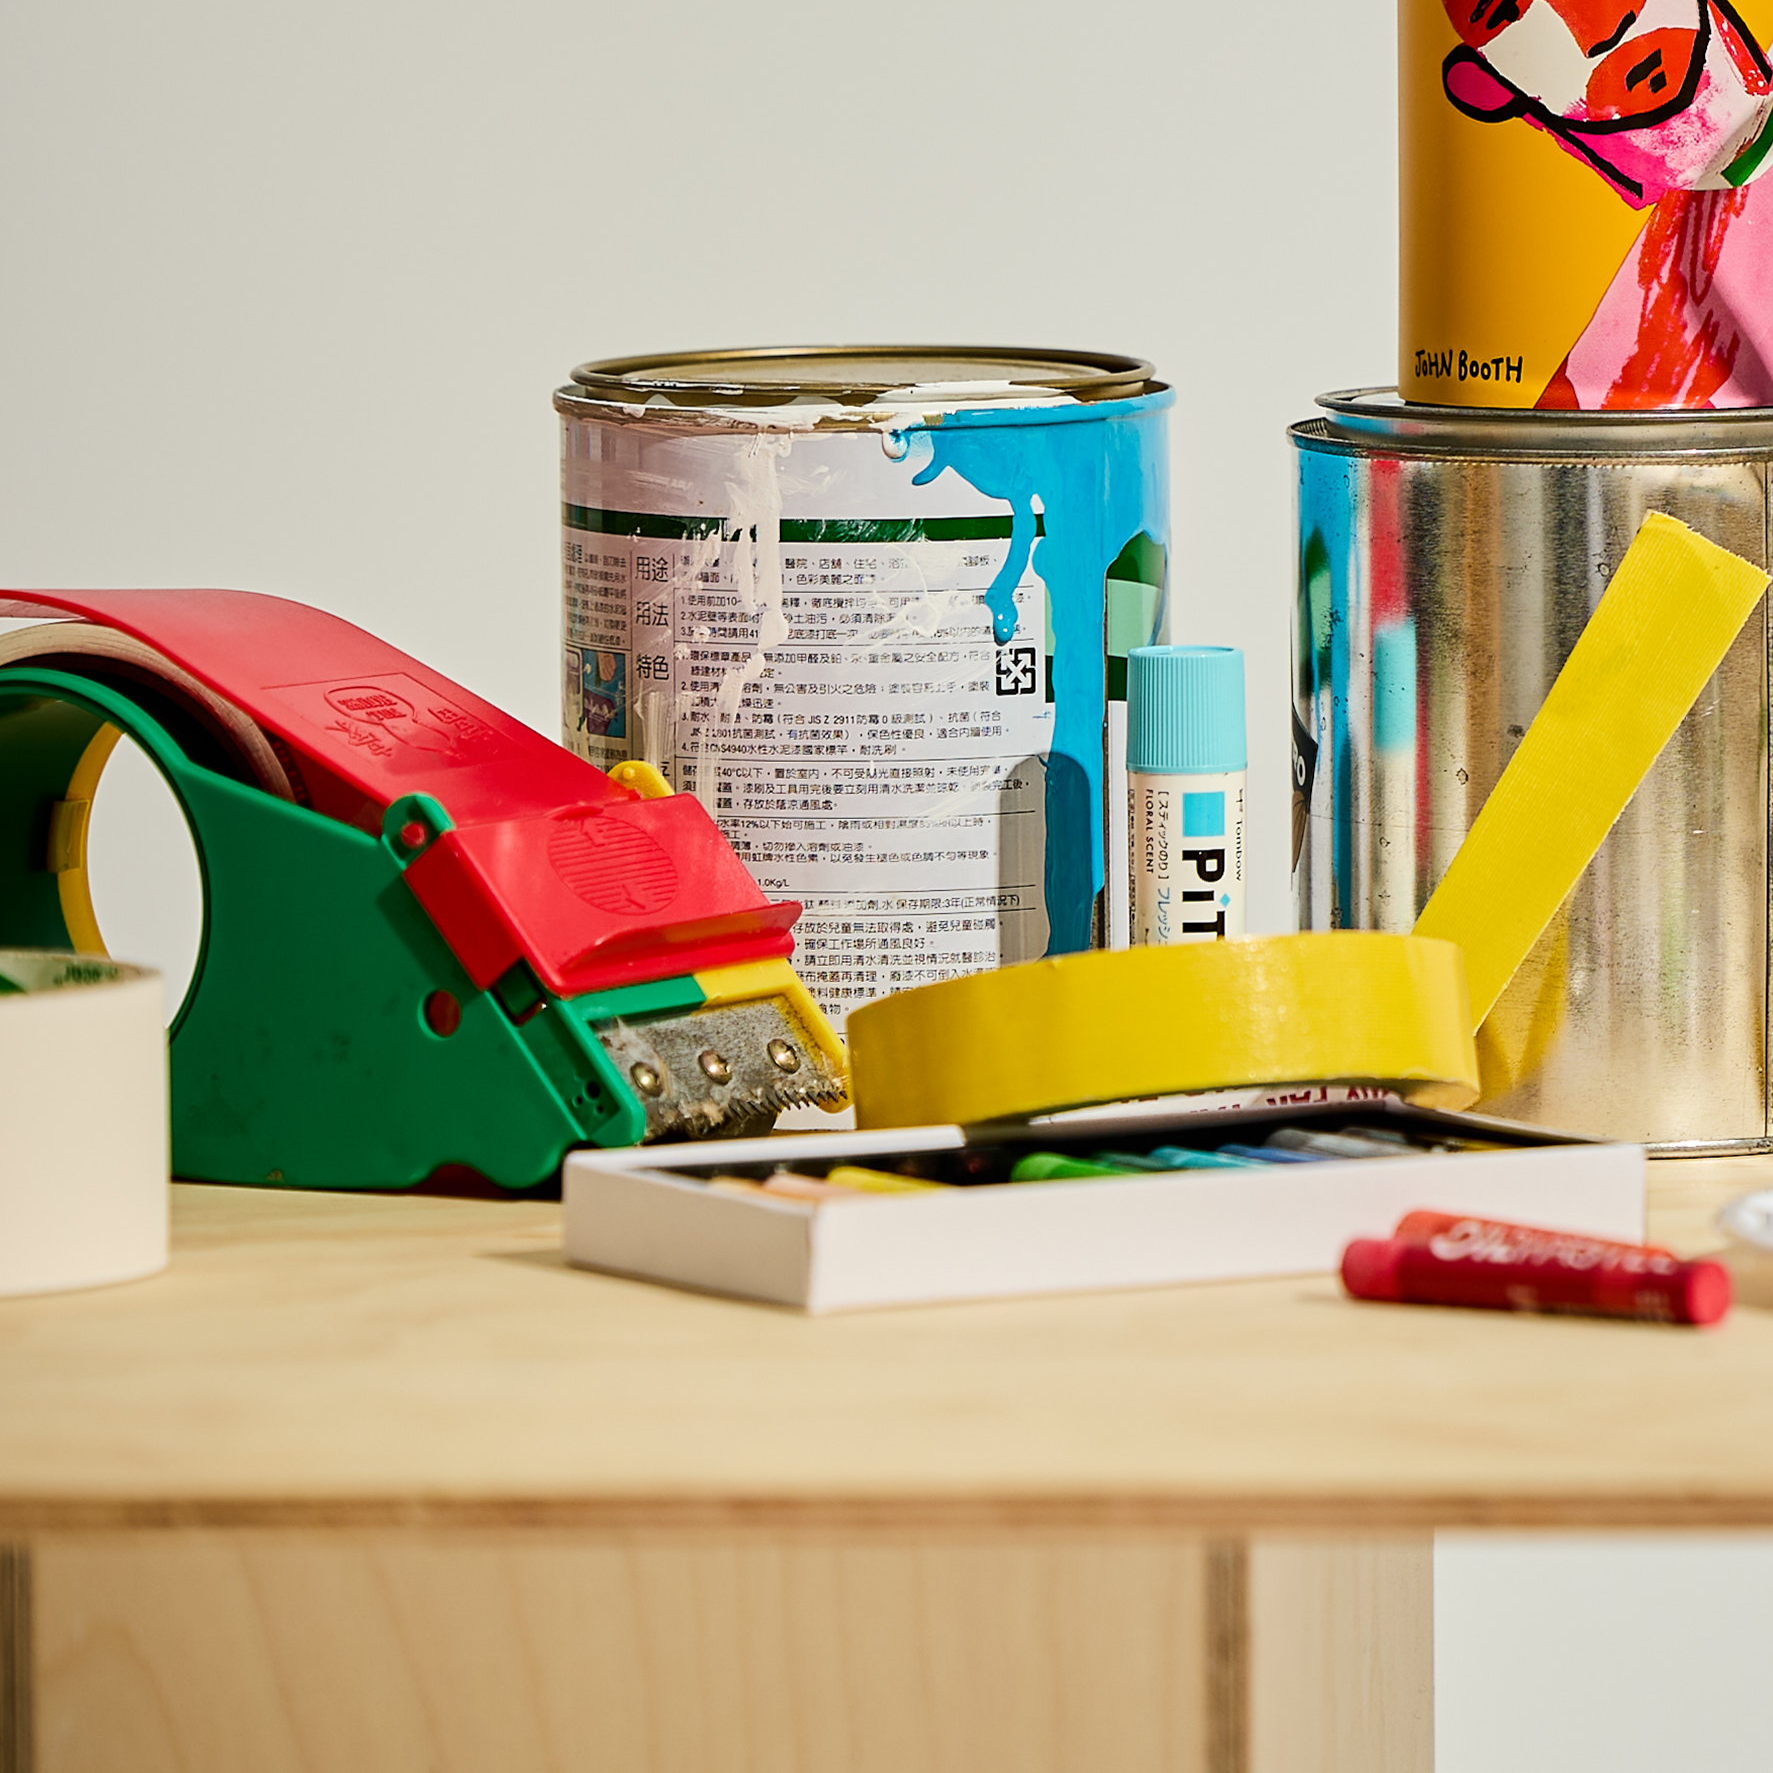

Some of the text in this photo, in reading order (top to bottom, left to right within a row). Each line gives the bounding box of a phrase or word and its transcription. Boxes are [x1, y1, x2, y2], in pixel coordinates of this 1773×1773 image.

[1458, 348, 1524, 384] BOOTH
[635, 555, 669, 583] 用途
[635, 600, 669, 627] 用法
[635, 654, 670, 681] 特色
[1145, 788, 1154, 874] FLORAL SCENT
[1235, 819, 1243, 882] Tombow
[757, 878, 790, 889] 1.0Kg/L
[1157, 887, 1171, 946] フレッシ
